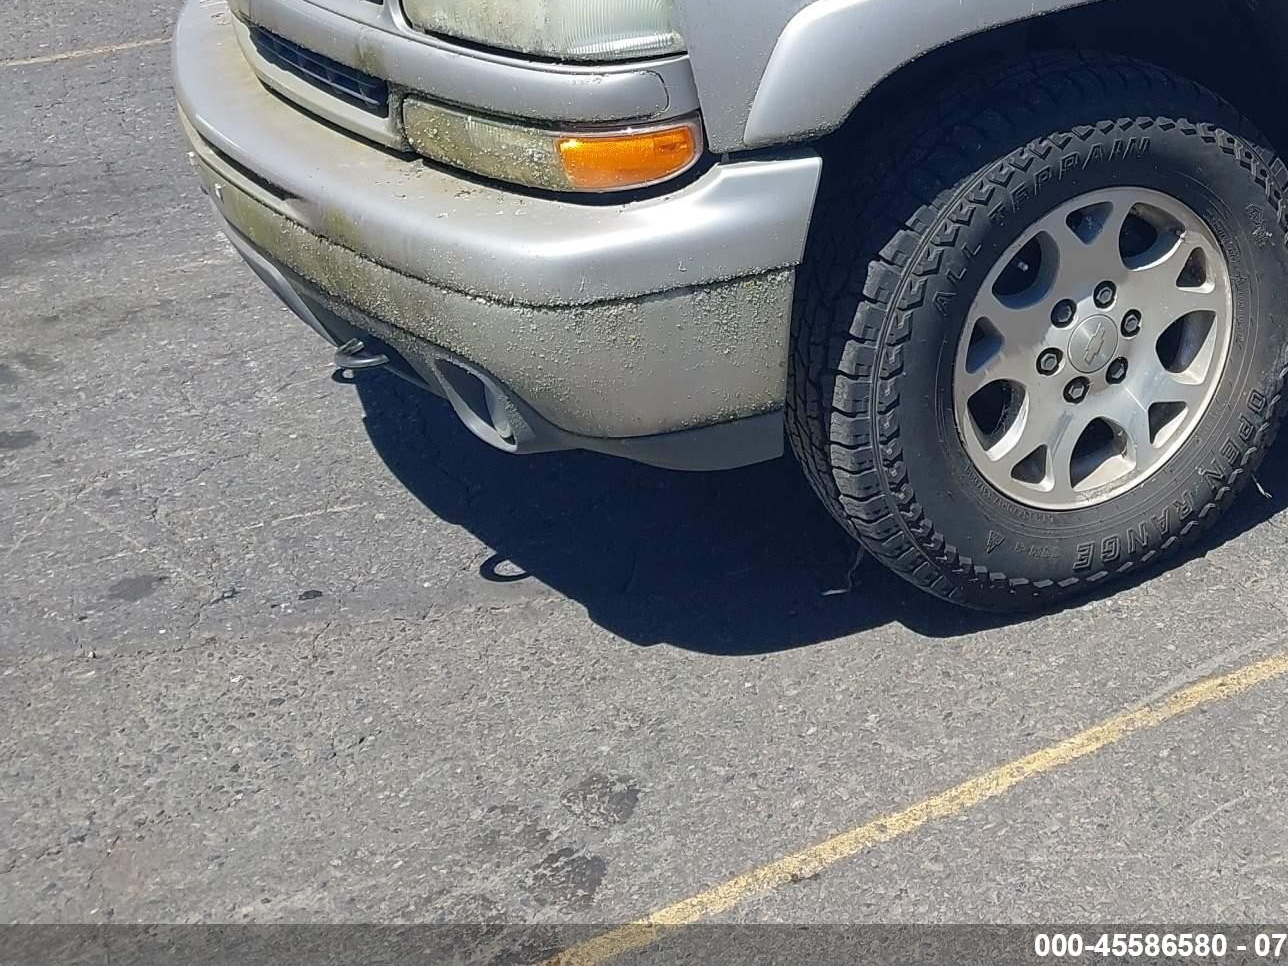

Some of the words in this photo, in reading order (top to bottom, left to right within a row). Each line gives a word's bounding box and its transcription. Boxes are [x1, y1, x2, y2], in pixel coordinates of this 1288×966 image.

[931, 243, 983, 317] ALL
[987, 136, 1151, 222] TERRAIN
[1202, 388, 1267, 490] OPEN
[1072, 489, 1196, 571] RANGE
